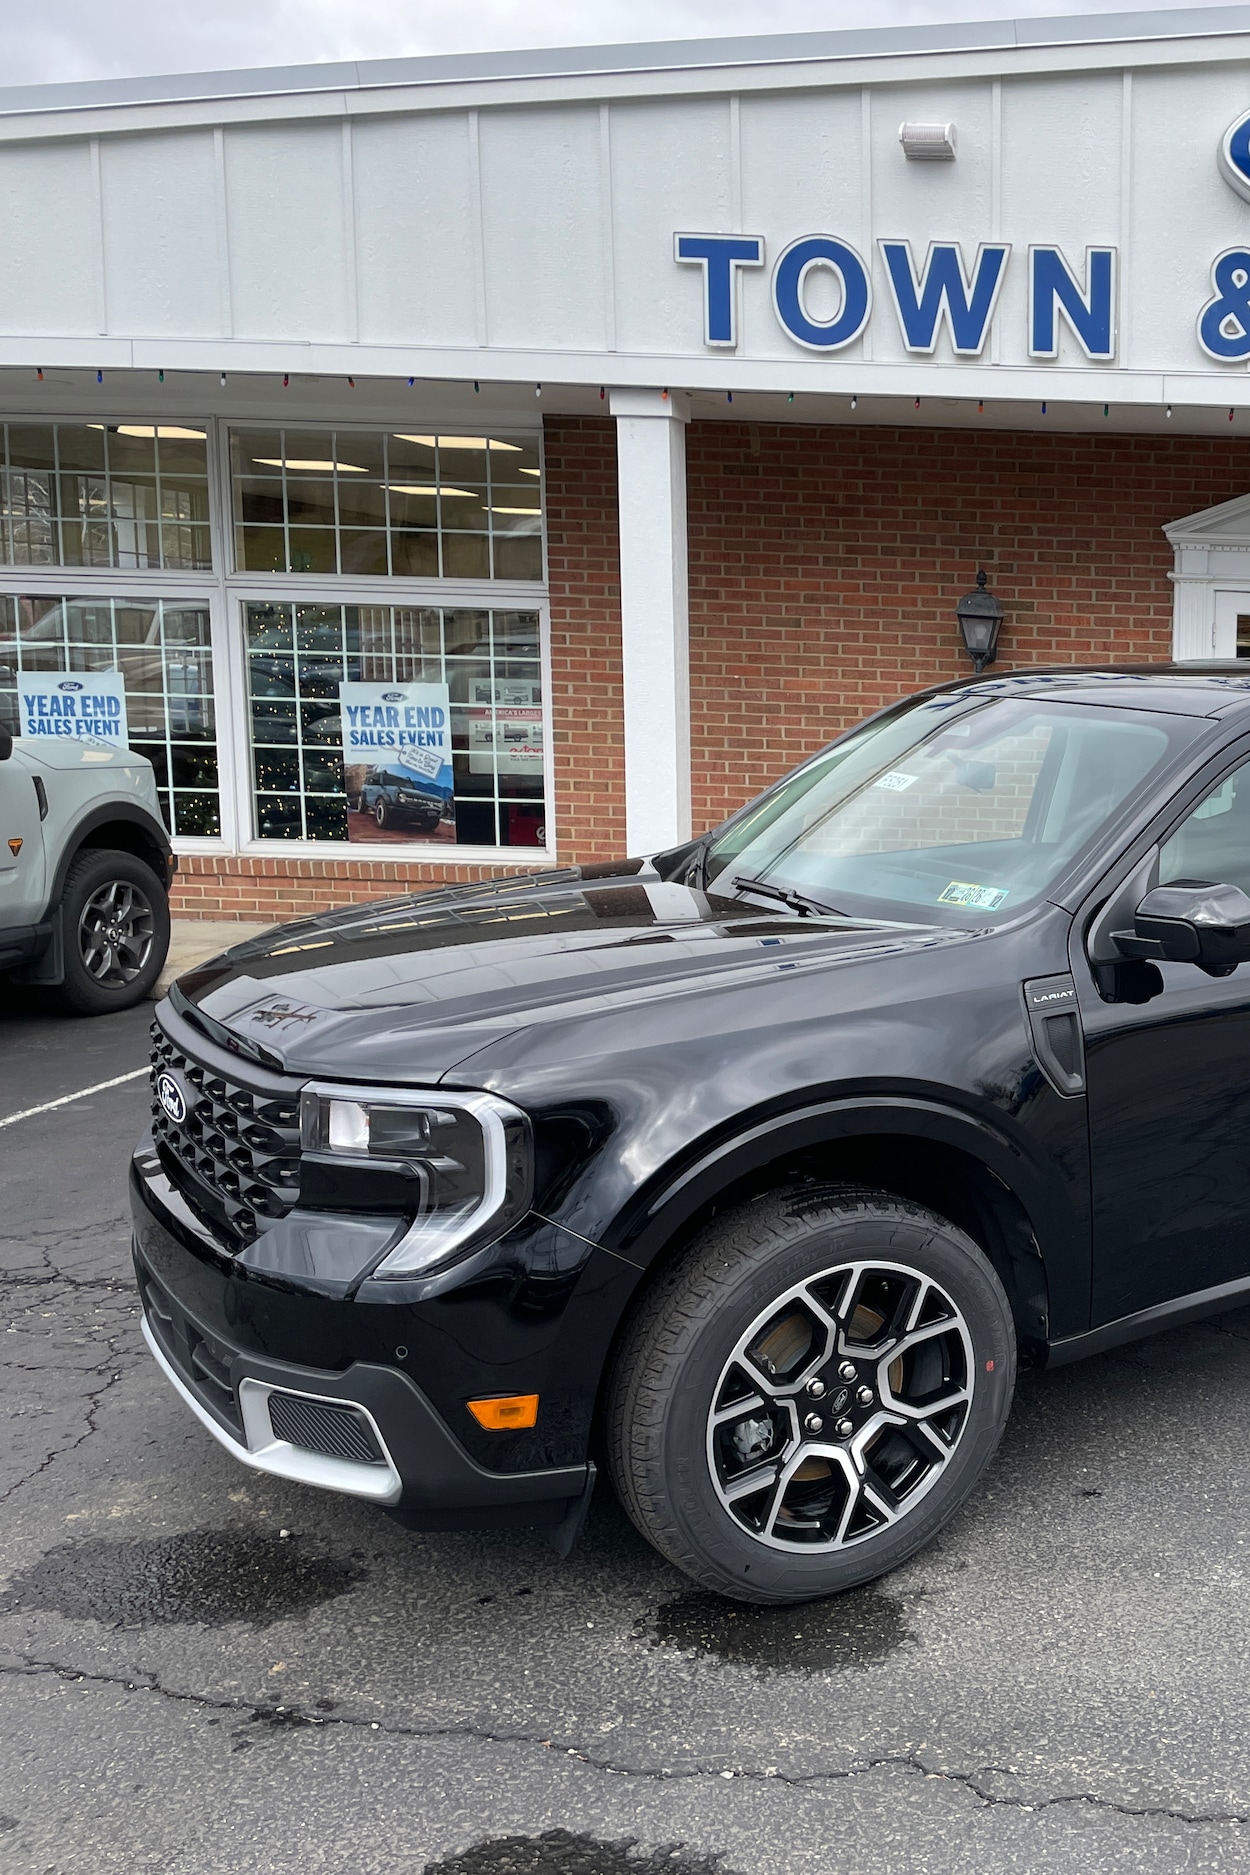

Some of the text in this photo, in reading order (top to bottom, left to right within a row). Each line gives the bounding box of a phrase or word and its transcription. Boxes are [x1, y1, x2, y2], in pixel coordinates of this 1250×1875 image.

[673, 231, 1118, 361] TOWN
[61, 682, 80, 691] Ford
[23, 695, 121, 717] YEAR END
[346, 706, 445, 728] YEAR END
[27, 719, 120, 736] SALES EVENT
[349, 730, 444, 747] SALES EVENT
[1033, 990, 1075, 1003] LARIAT
[161, 1077, 182, 1118] Ford
